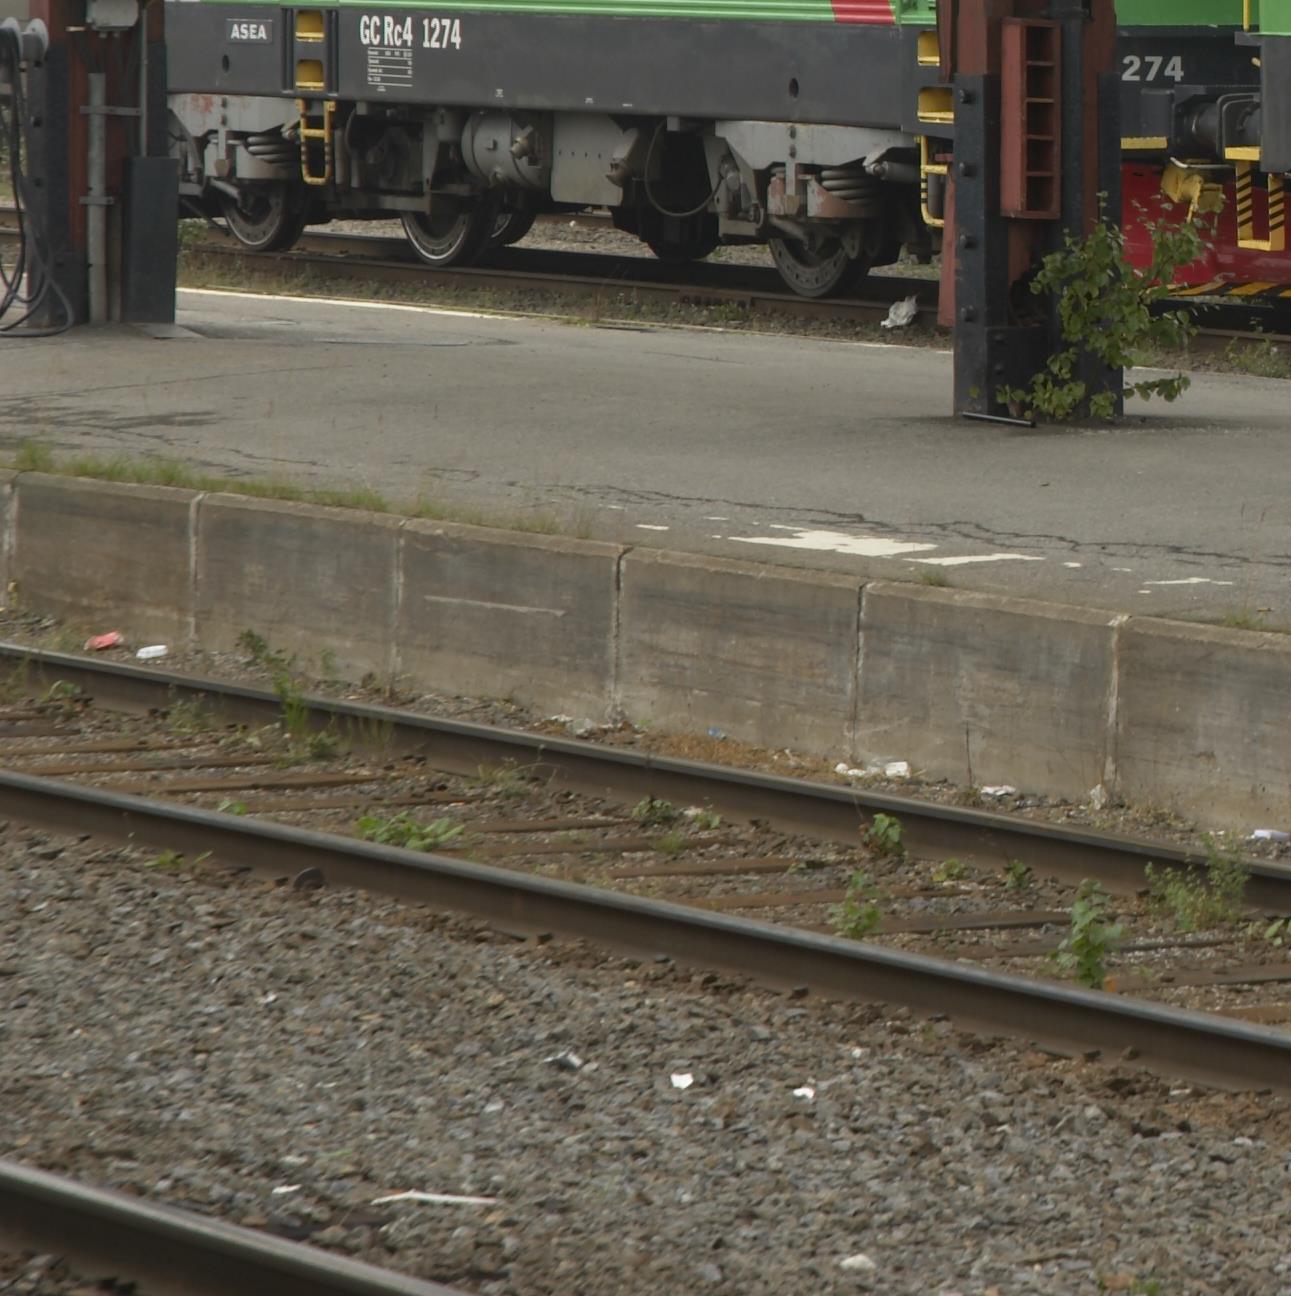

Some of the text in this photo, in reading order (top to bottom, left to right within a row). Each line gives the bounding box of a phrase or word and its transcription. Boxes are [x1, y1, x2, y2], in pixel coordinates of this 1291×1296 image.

[230, 23, 267, 41] ASEA
[360, 15, 462, 50] GC Rc4 1274
[1121, 55, 1184, 82] 274
